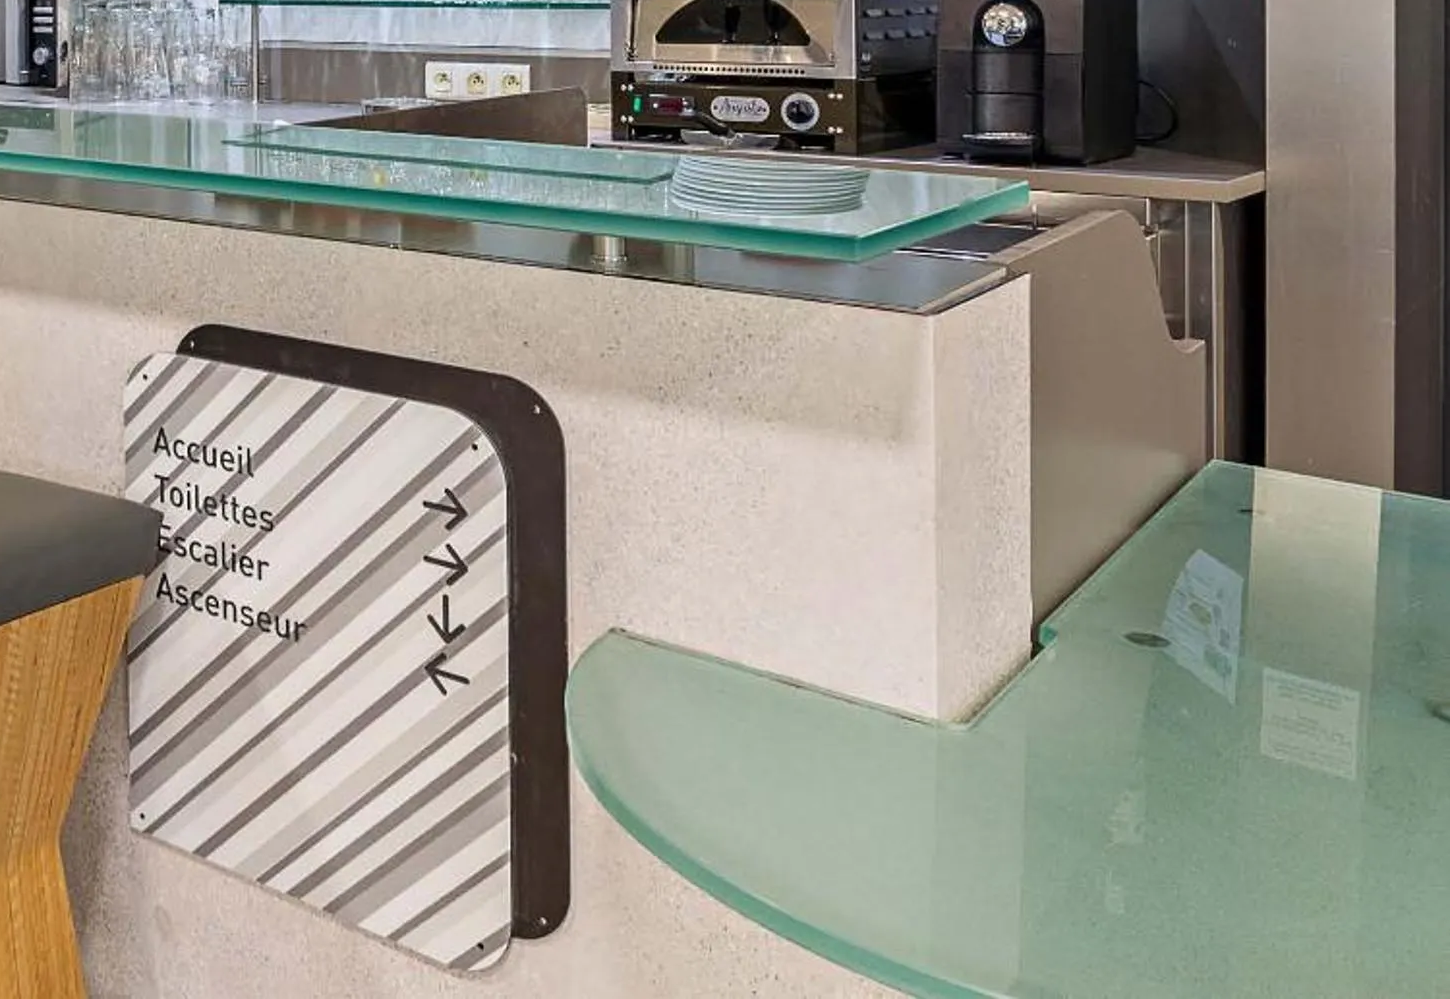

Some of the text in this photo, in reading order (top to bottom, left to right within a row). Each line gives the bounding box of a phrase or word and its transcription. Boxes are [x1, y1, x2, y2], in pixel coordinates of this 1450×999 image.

[153, 427, 255, 477] Accueil
[154, 474, 274, 532] Toilettes
[156, 524, 270, 580] Escalier
[156, 572, 308, 642] Ascenseur
